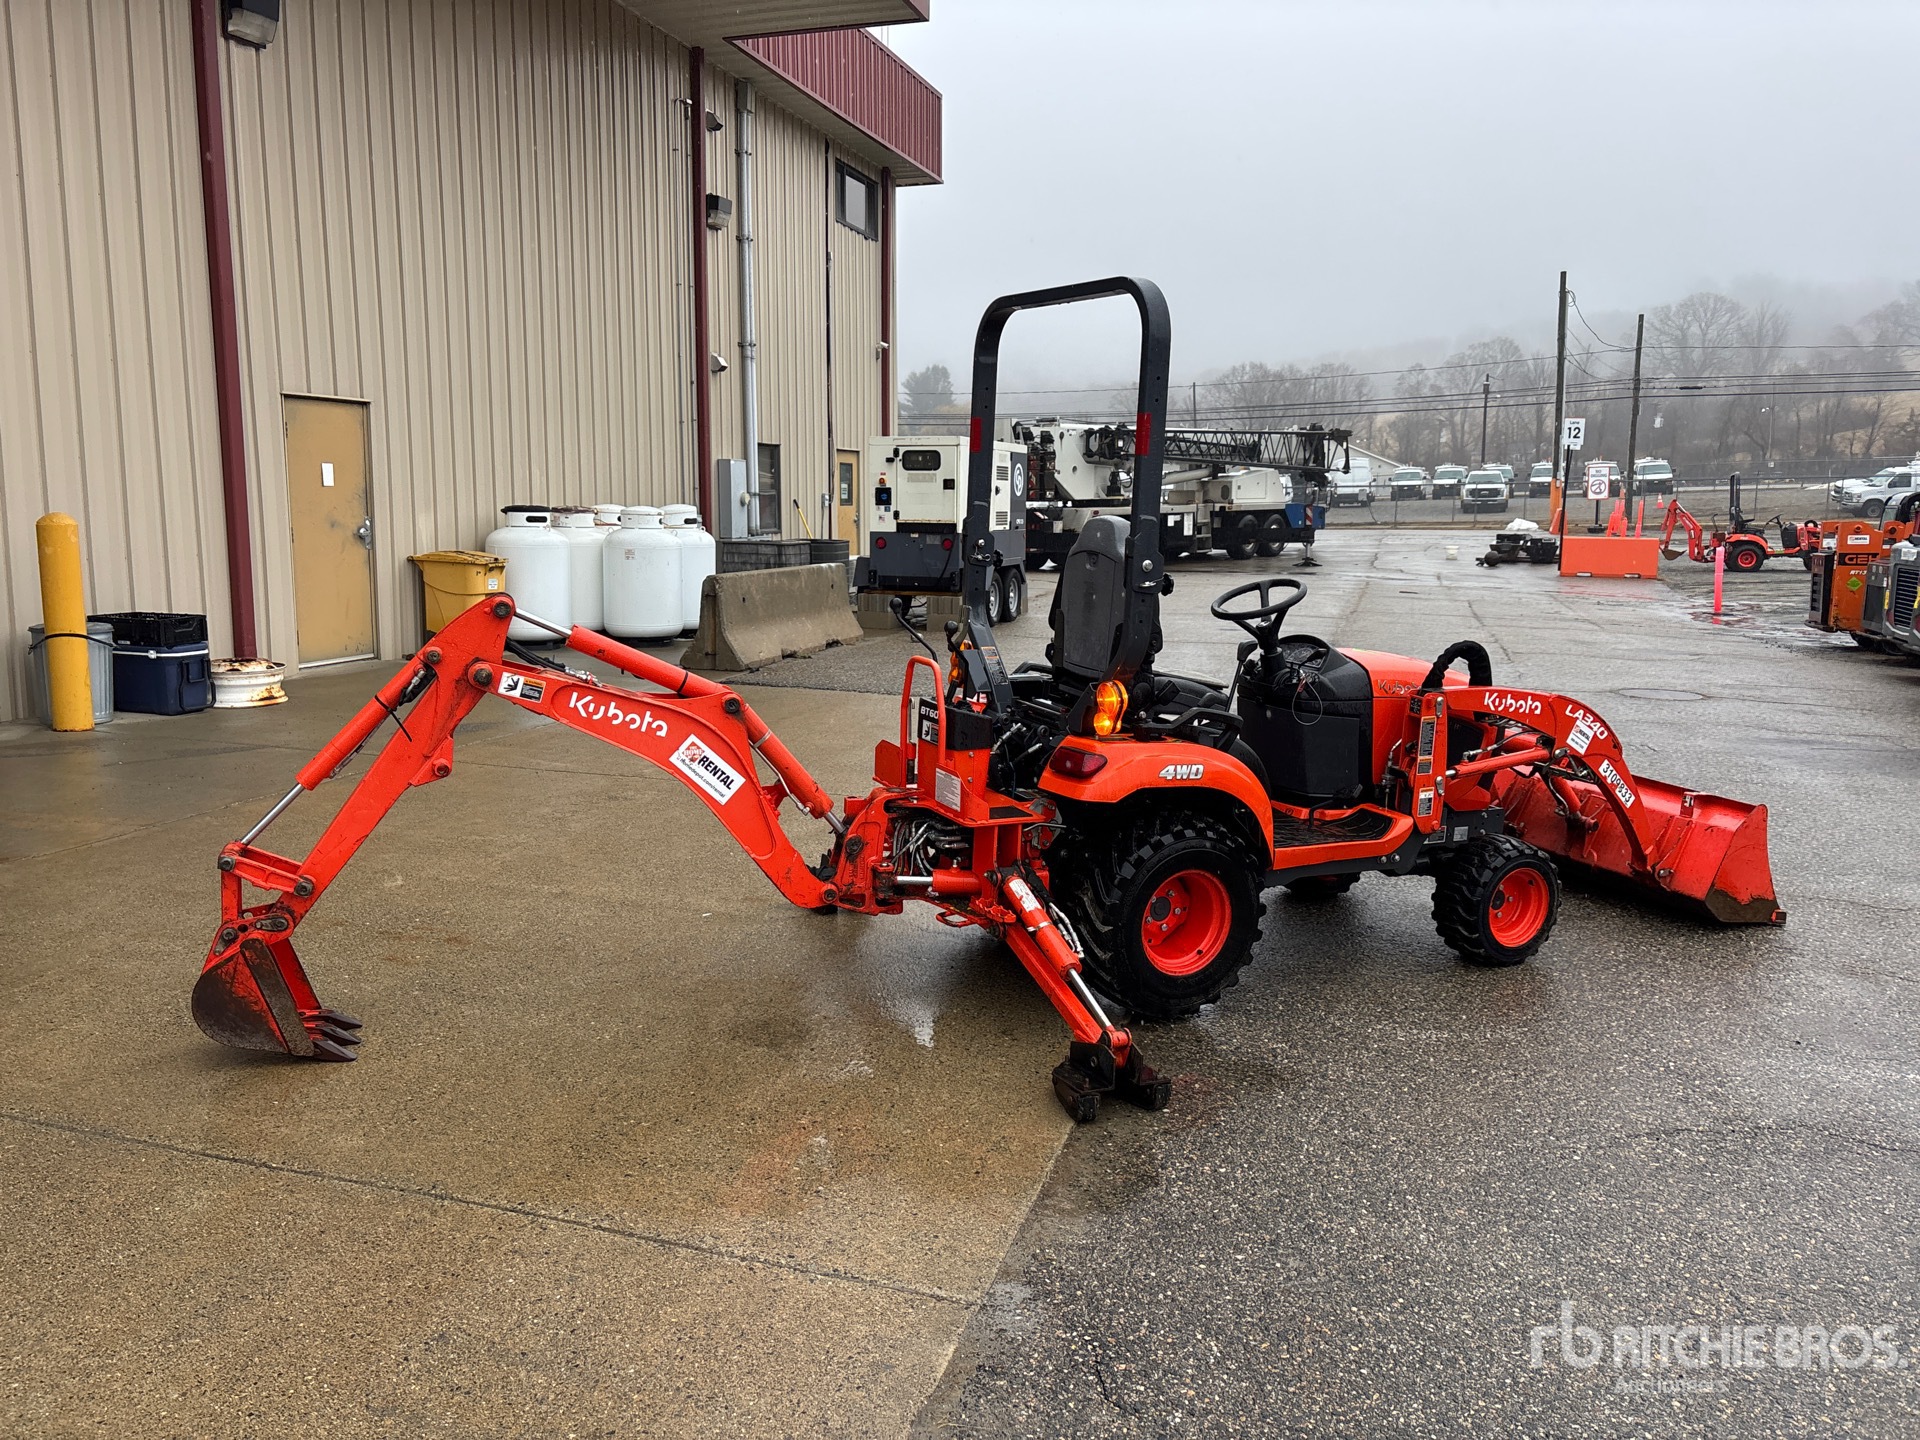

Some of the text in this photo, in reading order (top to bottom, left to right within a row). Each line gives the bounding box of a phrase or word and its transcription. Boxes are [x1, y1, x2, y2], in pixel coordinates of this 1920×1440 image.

[1567, 426, 1581, 439] 12
[569, 691, 668, 738] Kubota
[1483, 691, 1542, 715] Kubota
[1565, 704, 1608, 740] LA340
[697, 755, 734, 790] RENTAL
[1158, 764, 1204, 780] 4WD
